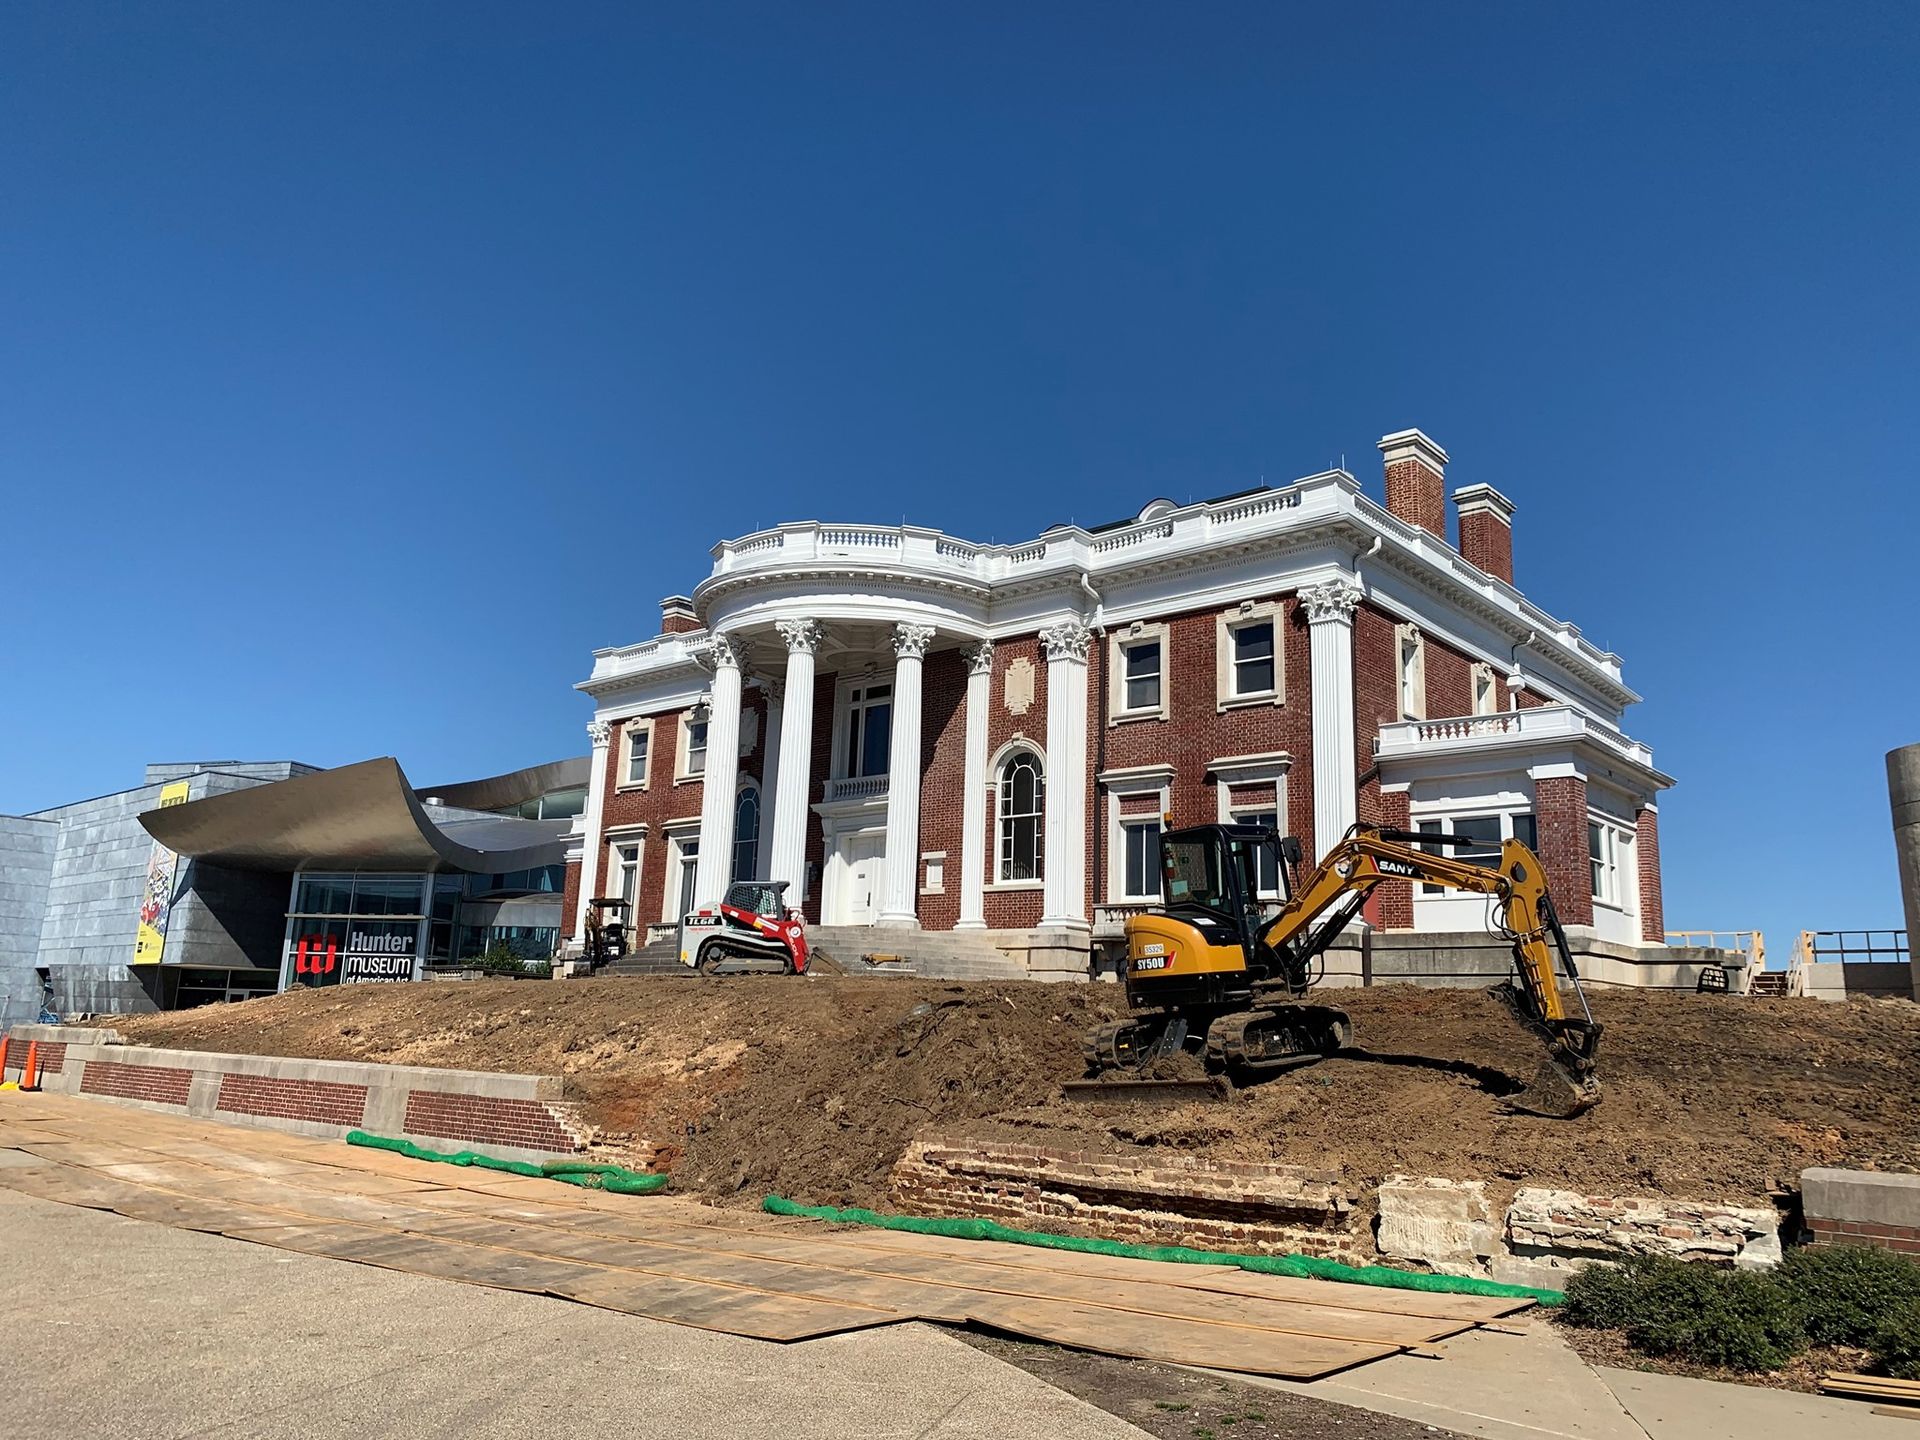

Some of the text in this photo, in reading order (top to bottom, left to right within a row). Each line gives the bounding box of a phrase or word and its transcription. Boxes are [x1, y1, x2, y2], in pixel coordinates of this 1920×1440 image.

[1379, 860, 1415, 875] SANY
[350, 931, 413, 952] Hunter
[1137, 957, 1165, 970] SY50U
[346, 975, 356, 984] of
